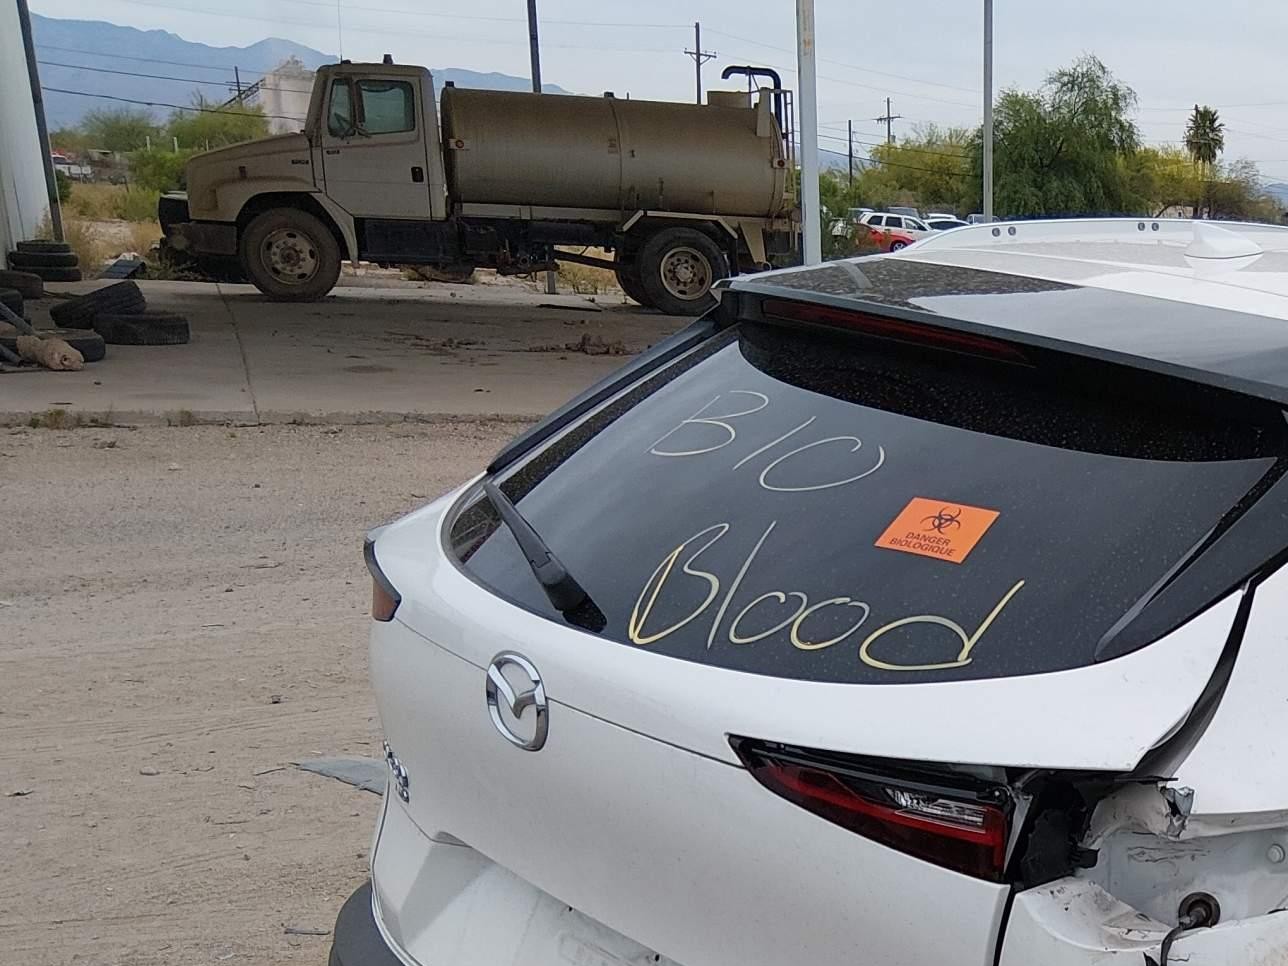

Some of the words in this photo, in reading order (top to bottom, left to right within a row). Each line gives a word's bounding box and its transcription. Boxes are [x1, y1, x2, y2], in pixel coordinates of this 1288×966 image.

[889, 537, 957, 557] BIOLOGIQUE
[905, 531, 952, 547] DANGER
[628, 520, 1026, 671] Blood
